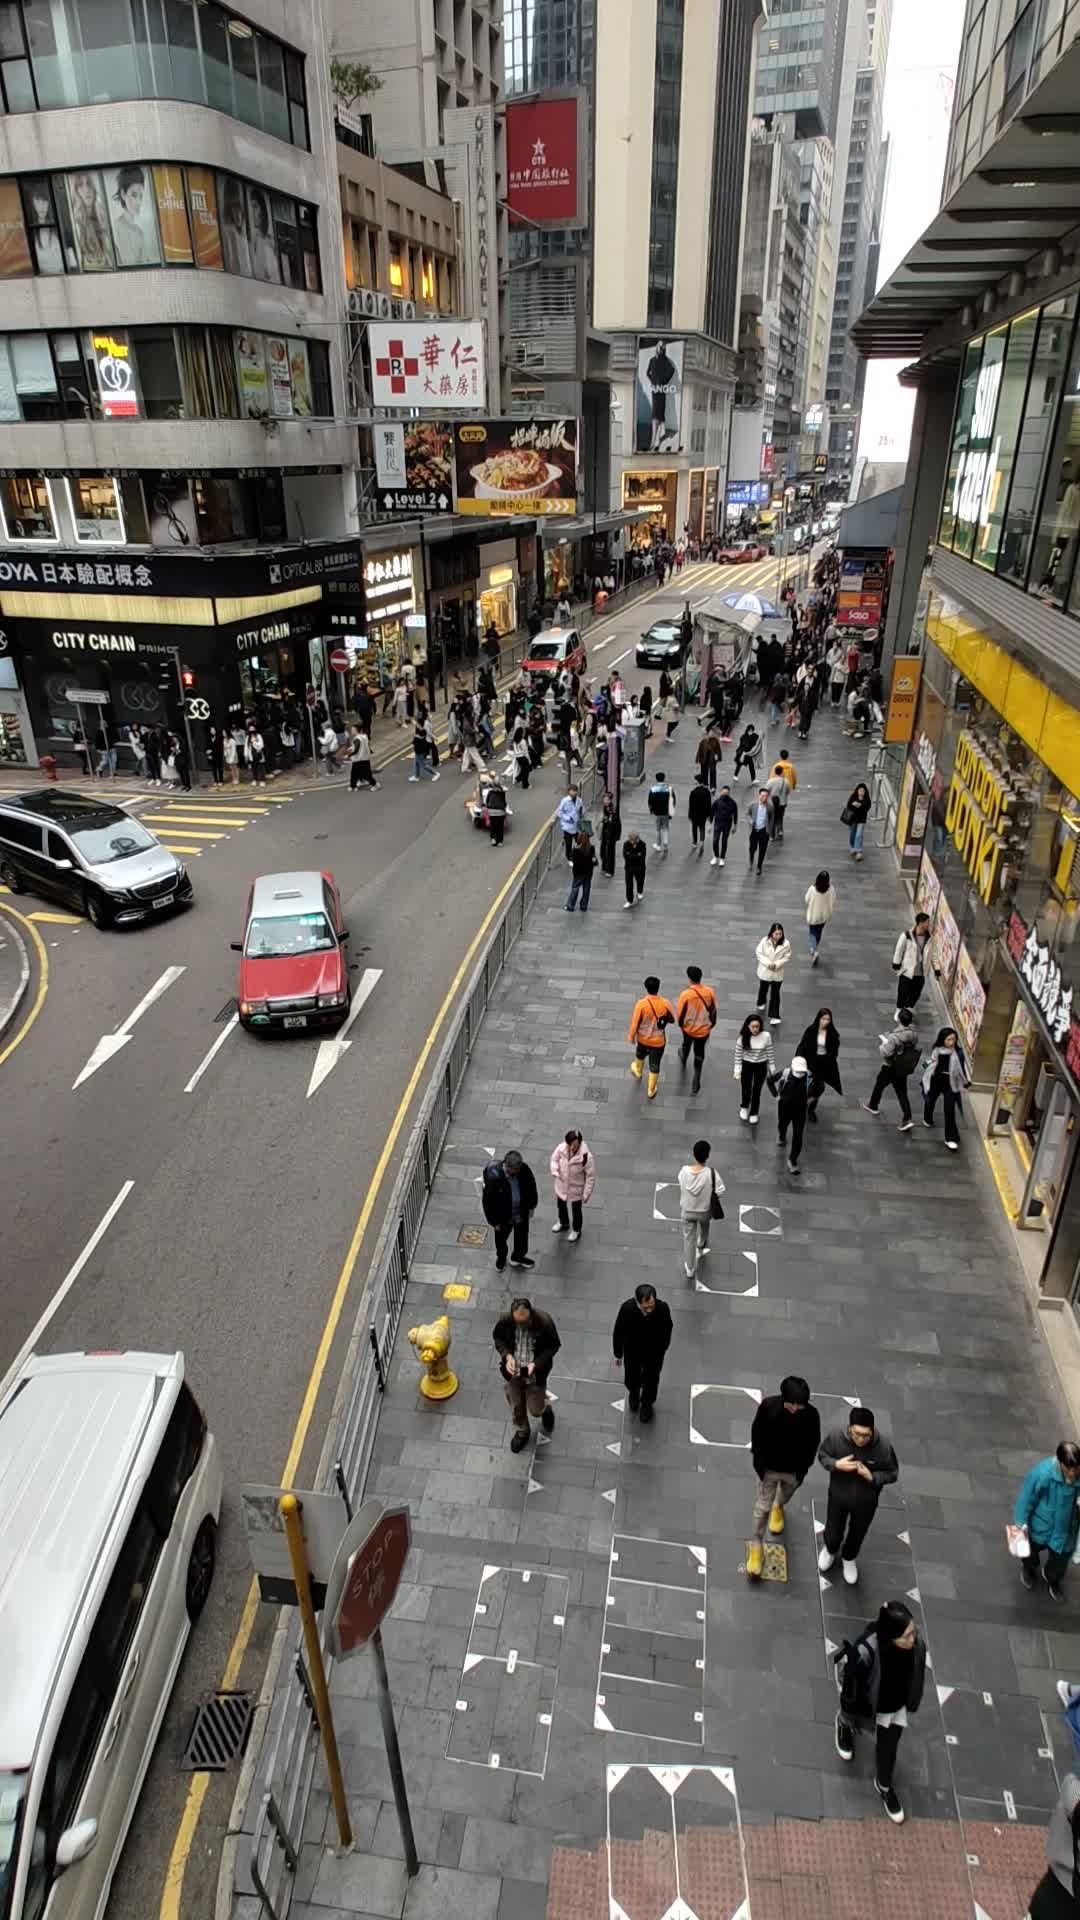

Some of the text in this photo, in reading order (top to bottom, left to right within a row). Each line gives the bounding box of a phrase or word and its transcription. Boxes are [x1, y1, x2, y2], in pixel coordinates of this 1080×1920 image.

[419, 333, 478, 373] 華仁
[423, 373, 469, 396] 大藥房
[395, 492, 436, 505] Level 2
[41, 563, 153, 586] 日本驗配概念
[283, 560, 314, 580] OPTICAL
[314, 558, 324, 574] 88
[52, 631, 85, 650] CITY
[89, 634, 136, 652] CHAIN
[236, 628, 260, 650] CITY
[261, 622, 291, 643] CHAIN
[945, 768, 1000, 906] DONKI
[352, 1529, 393, 1599] STOP
